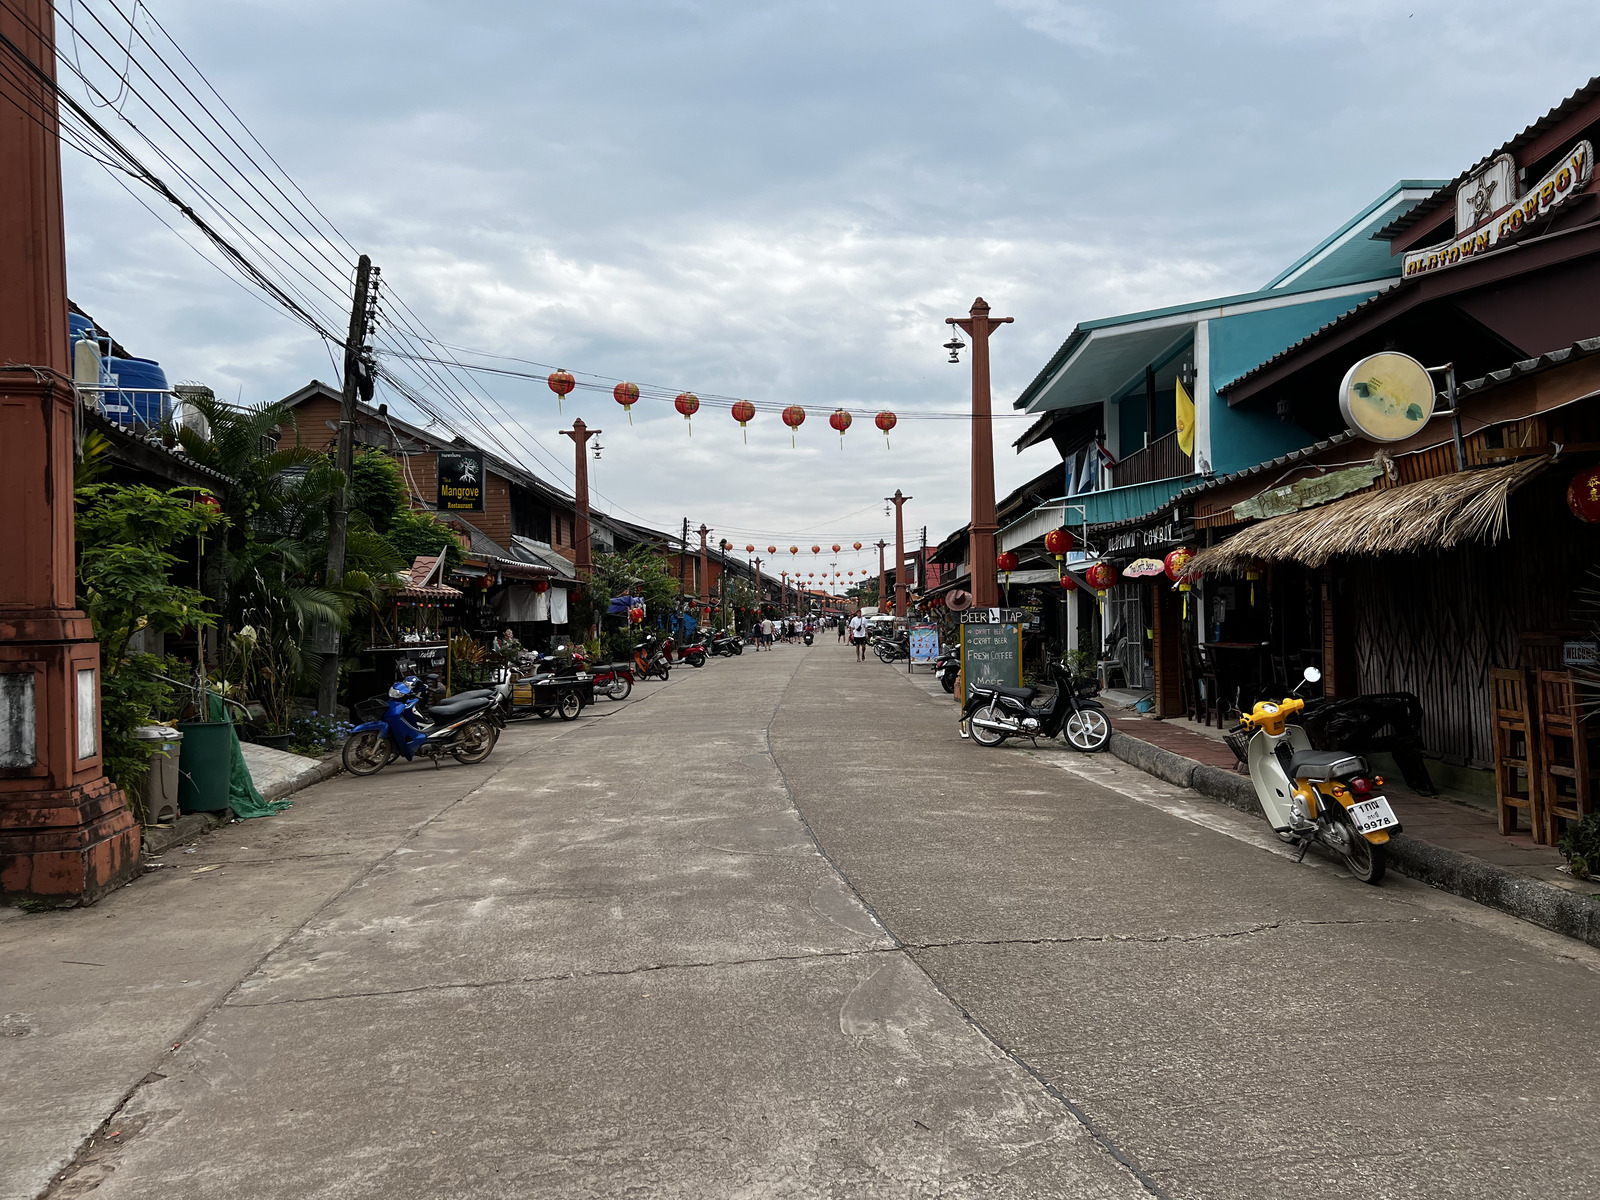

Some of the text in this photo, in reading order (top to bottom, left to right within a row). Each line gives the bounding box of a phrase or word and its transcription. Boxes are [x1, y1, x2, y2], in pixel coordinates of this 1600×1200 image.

[1407, 152, 1585, 276] OLDTOWN COWBOY
[441, 485, 479, 499] Mangrove
[960, 609, 1023, 623] BEER TAP
[994, 637, 1008, 645] BEER
[967, 649, 1013, 660] FRESH COFFEE
[1566, 647, 1596, 660] WELCO
[1363, 817, 1391, 831] 9978
